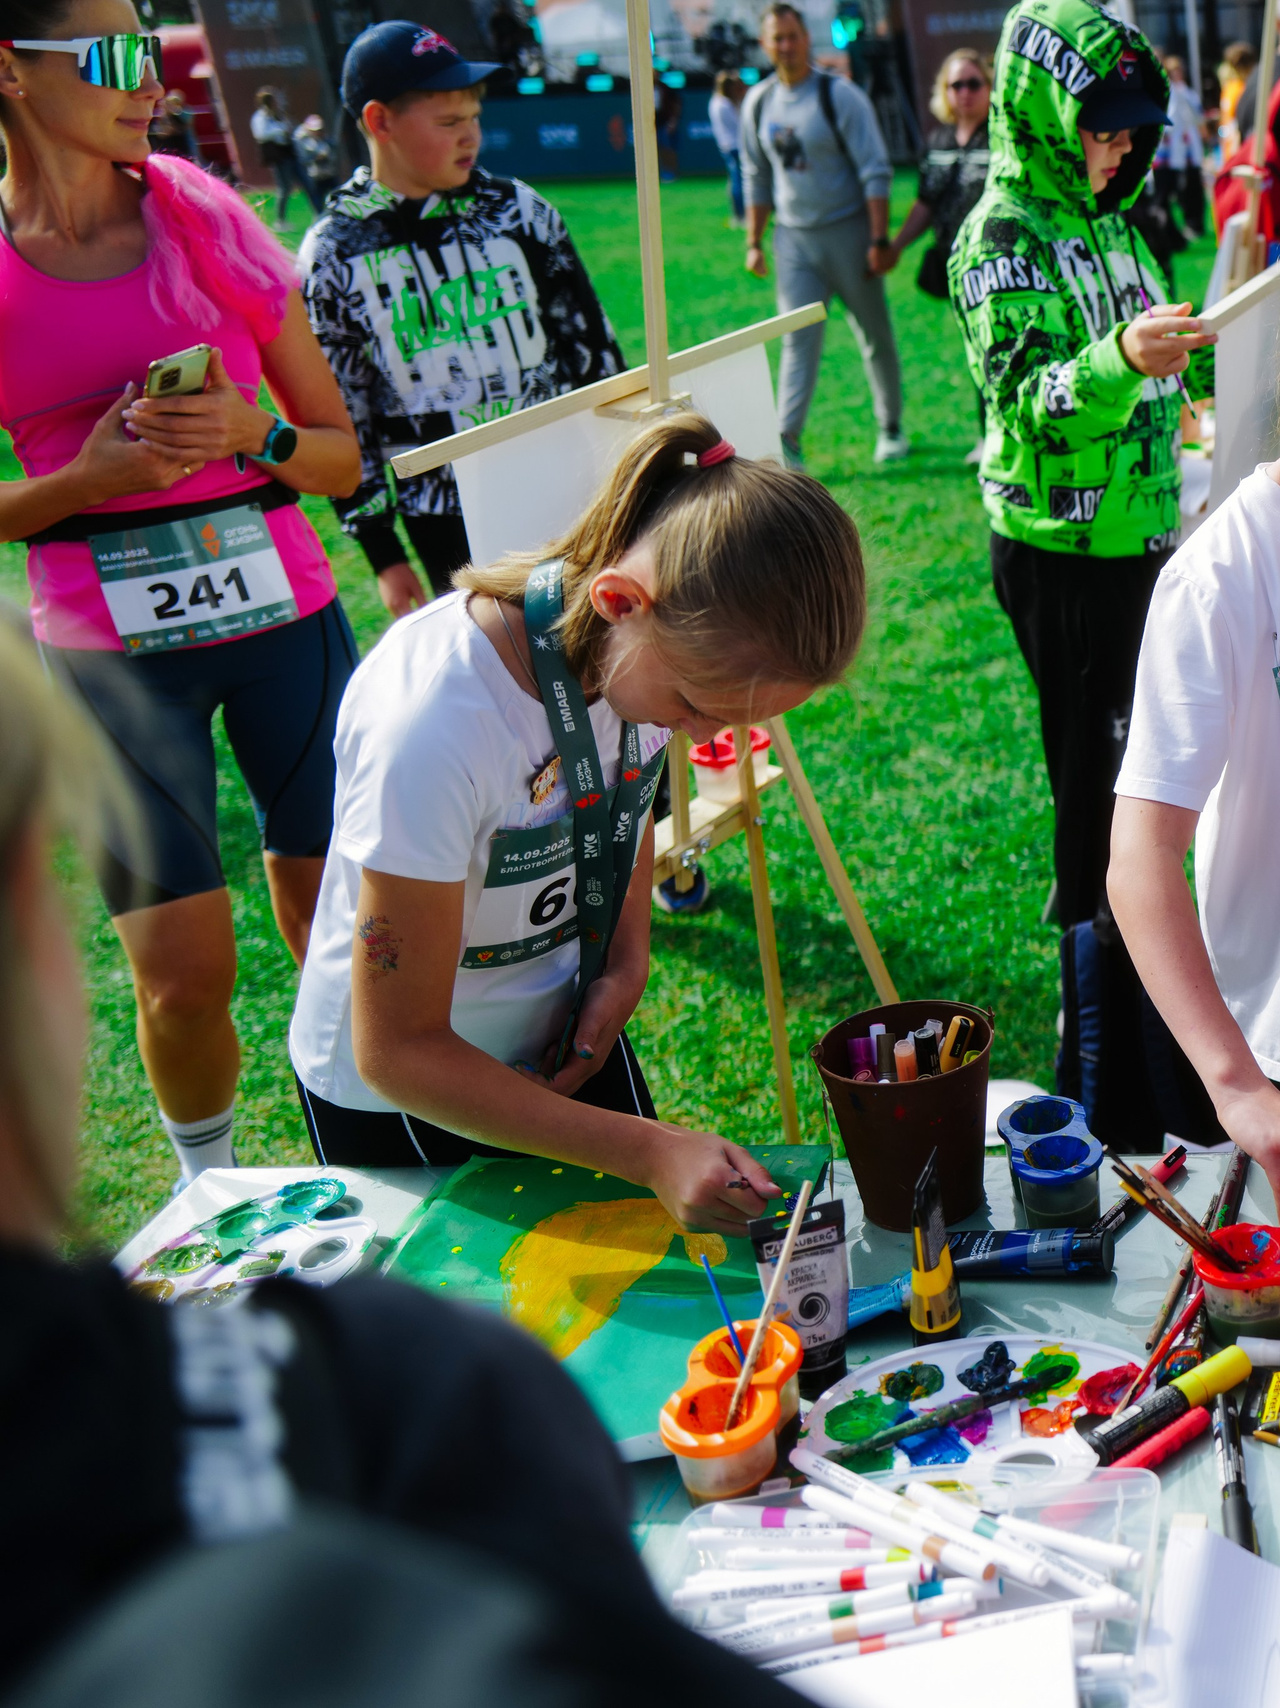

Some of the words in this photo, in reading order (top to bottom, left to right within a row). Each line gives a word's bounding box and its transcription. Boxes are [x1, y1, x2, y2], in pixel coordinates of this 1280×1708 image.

[147, 566, 250, 621] 241
[553, 681, 573, 721] MAER
[575, 762, 587, 791] ОГОНЬ
[582, 757, 595, 790] ЖИЗНИ
[503, 836, 570, 863] 14.09.2025
[530, 877, 577, 926] 6
